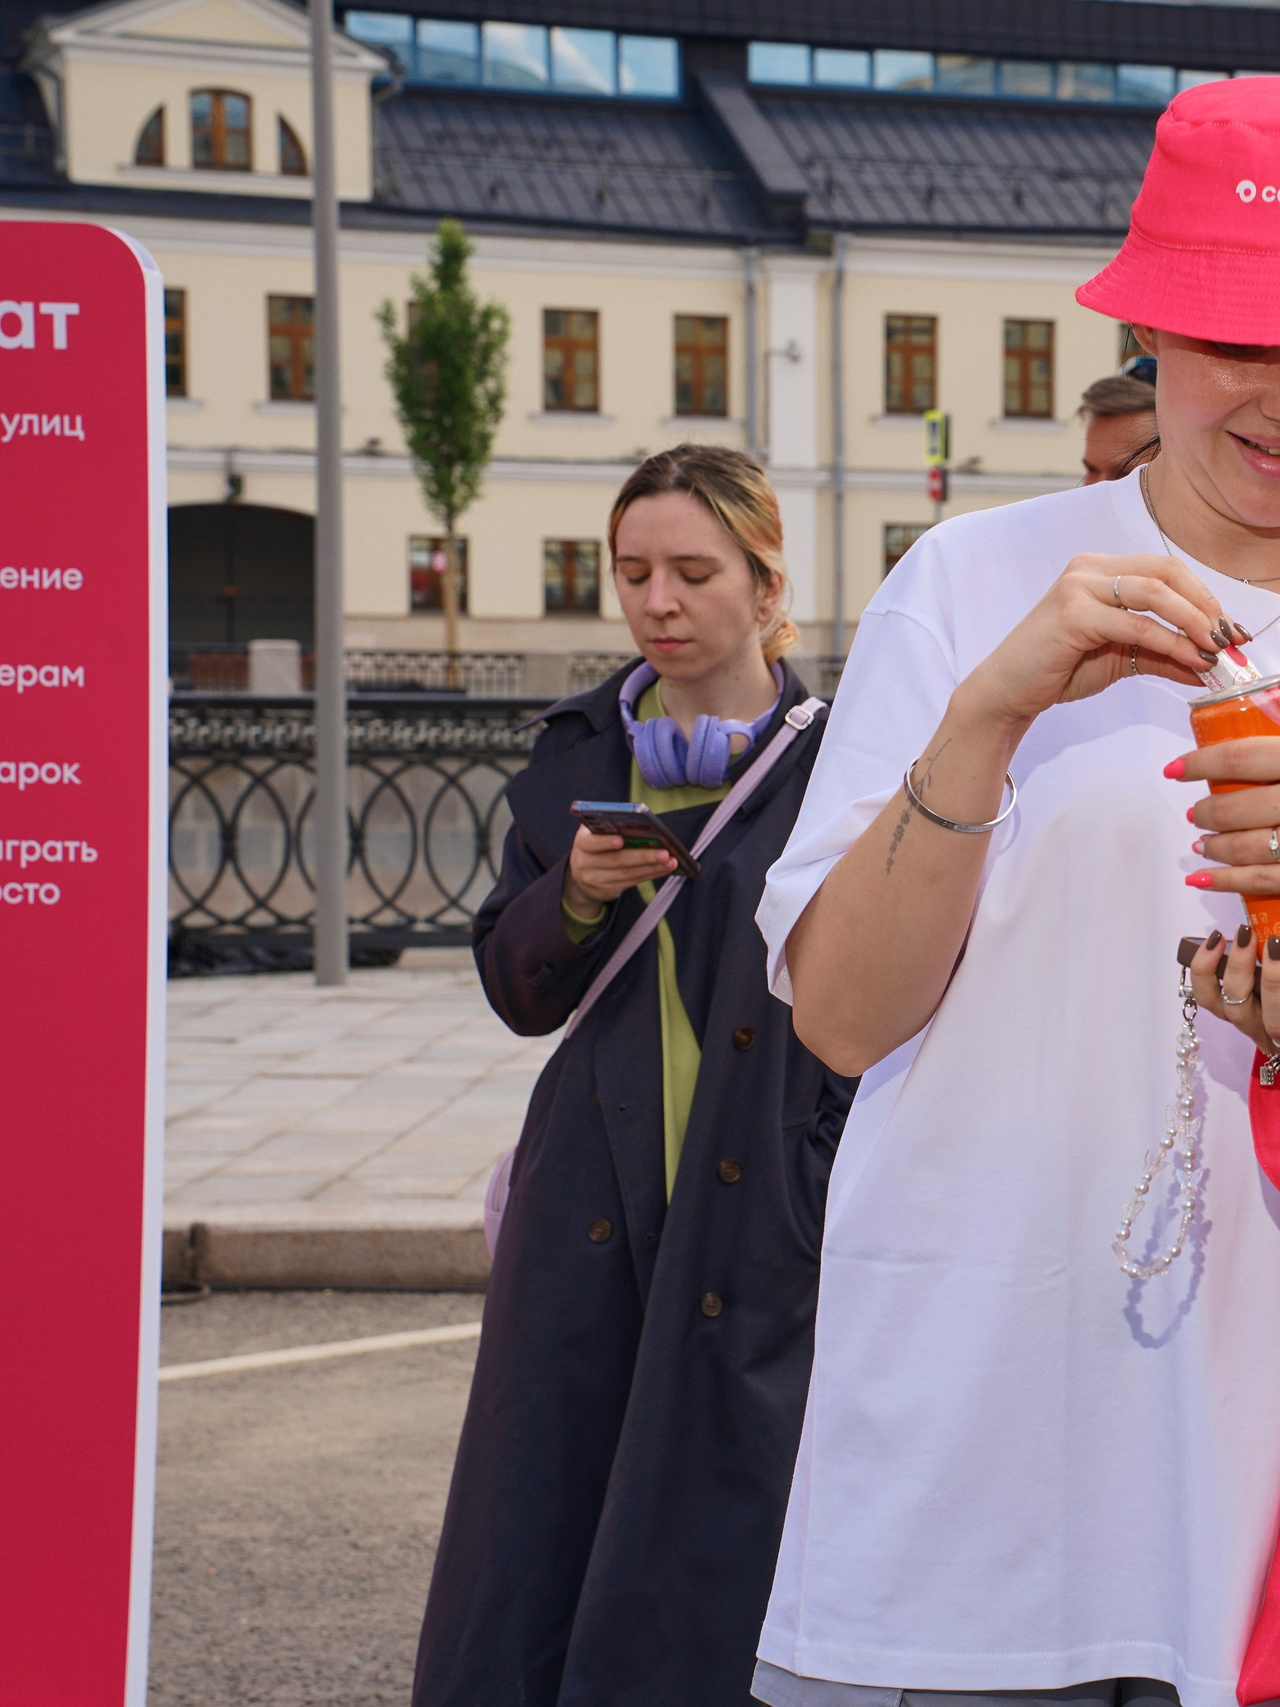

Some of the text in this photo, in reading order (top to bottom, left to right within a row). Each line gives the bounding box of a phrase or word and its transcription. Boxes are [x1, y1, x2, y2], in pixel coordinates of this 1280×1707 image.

[0, 300, 80, 350] ат
[0, 413, 85, 442] улиц
[0, 566, 83, 591] ение
[0, 664, 84, 694] ерам
[0, 761, 82, 791] арок
[0, 839, 98, 870] грать
[0, 882, 61, 905] сто
